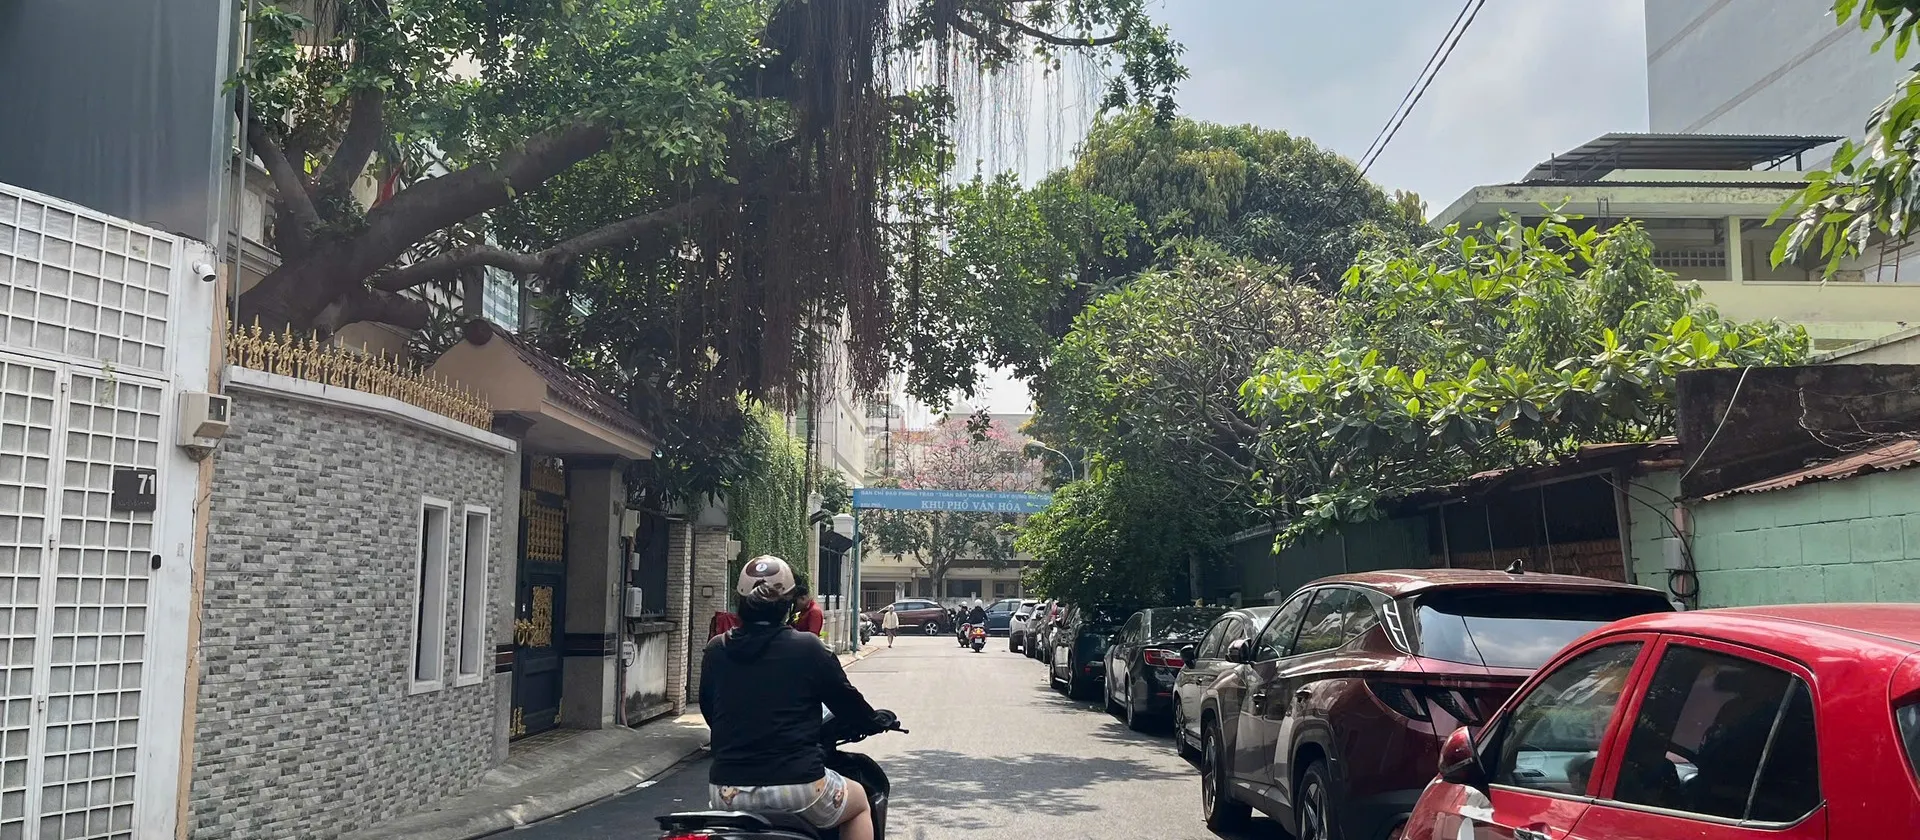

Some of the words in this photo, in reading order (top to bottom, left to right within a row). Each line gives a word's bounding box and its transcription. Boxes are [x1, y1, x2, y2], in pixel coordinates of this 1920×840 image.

[138, 474, 155, 495] 71
[921, 500, 944, 509] KHU
[947, 497, 969, 510] PHỐ
[998, 500, 1021, 511] HÓA
